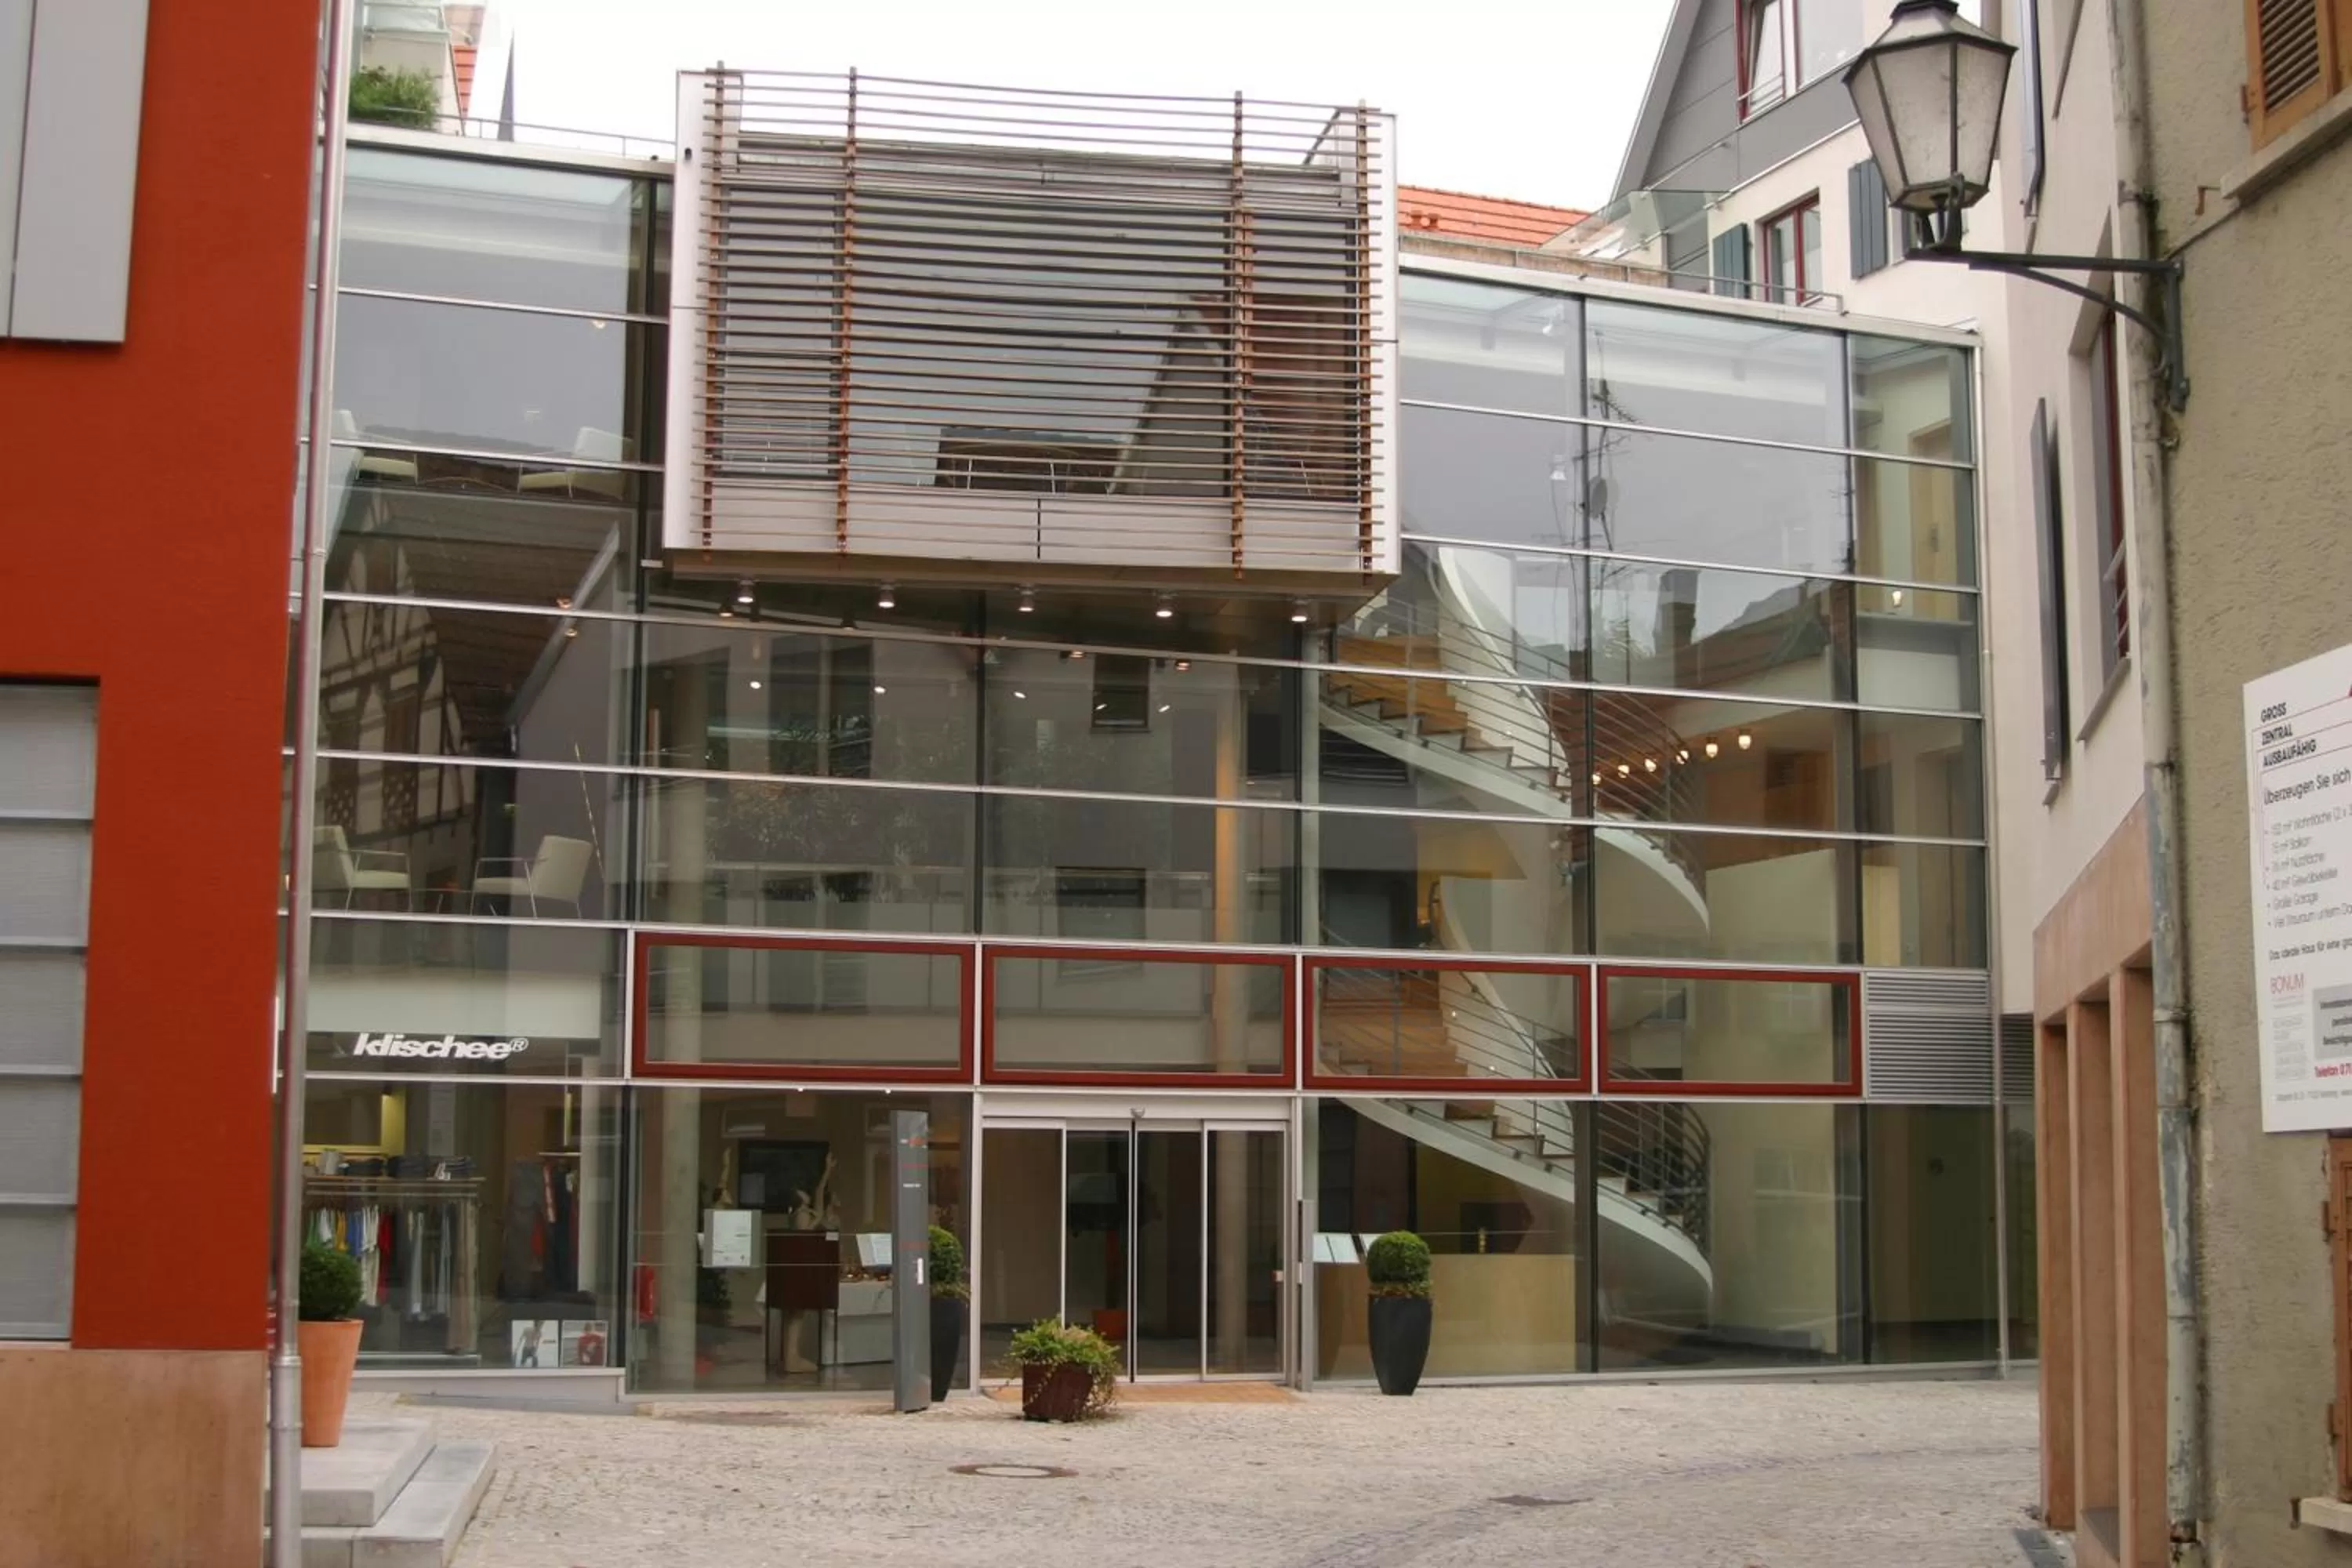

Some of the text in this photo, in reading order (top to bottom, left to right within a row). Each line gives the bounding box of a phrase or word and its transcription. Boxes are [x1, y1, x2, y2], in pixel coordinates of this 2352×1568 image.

[2261, 702, 2286, 722] GROSS
[2262, 724, 2292, 746] ZENTRAL
[2263, 739, 2317, 766] AUSBAUFÄHIG
[2263, 769, 2351, 805] Überzeugen Sie sich
